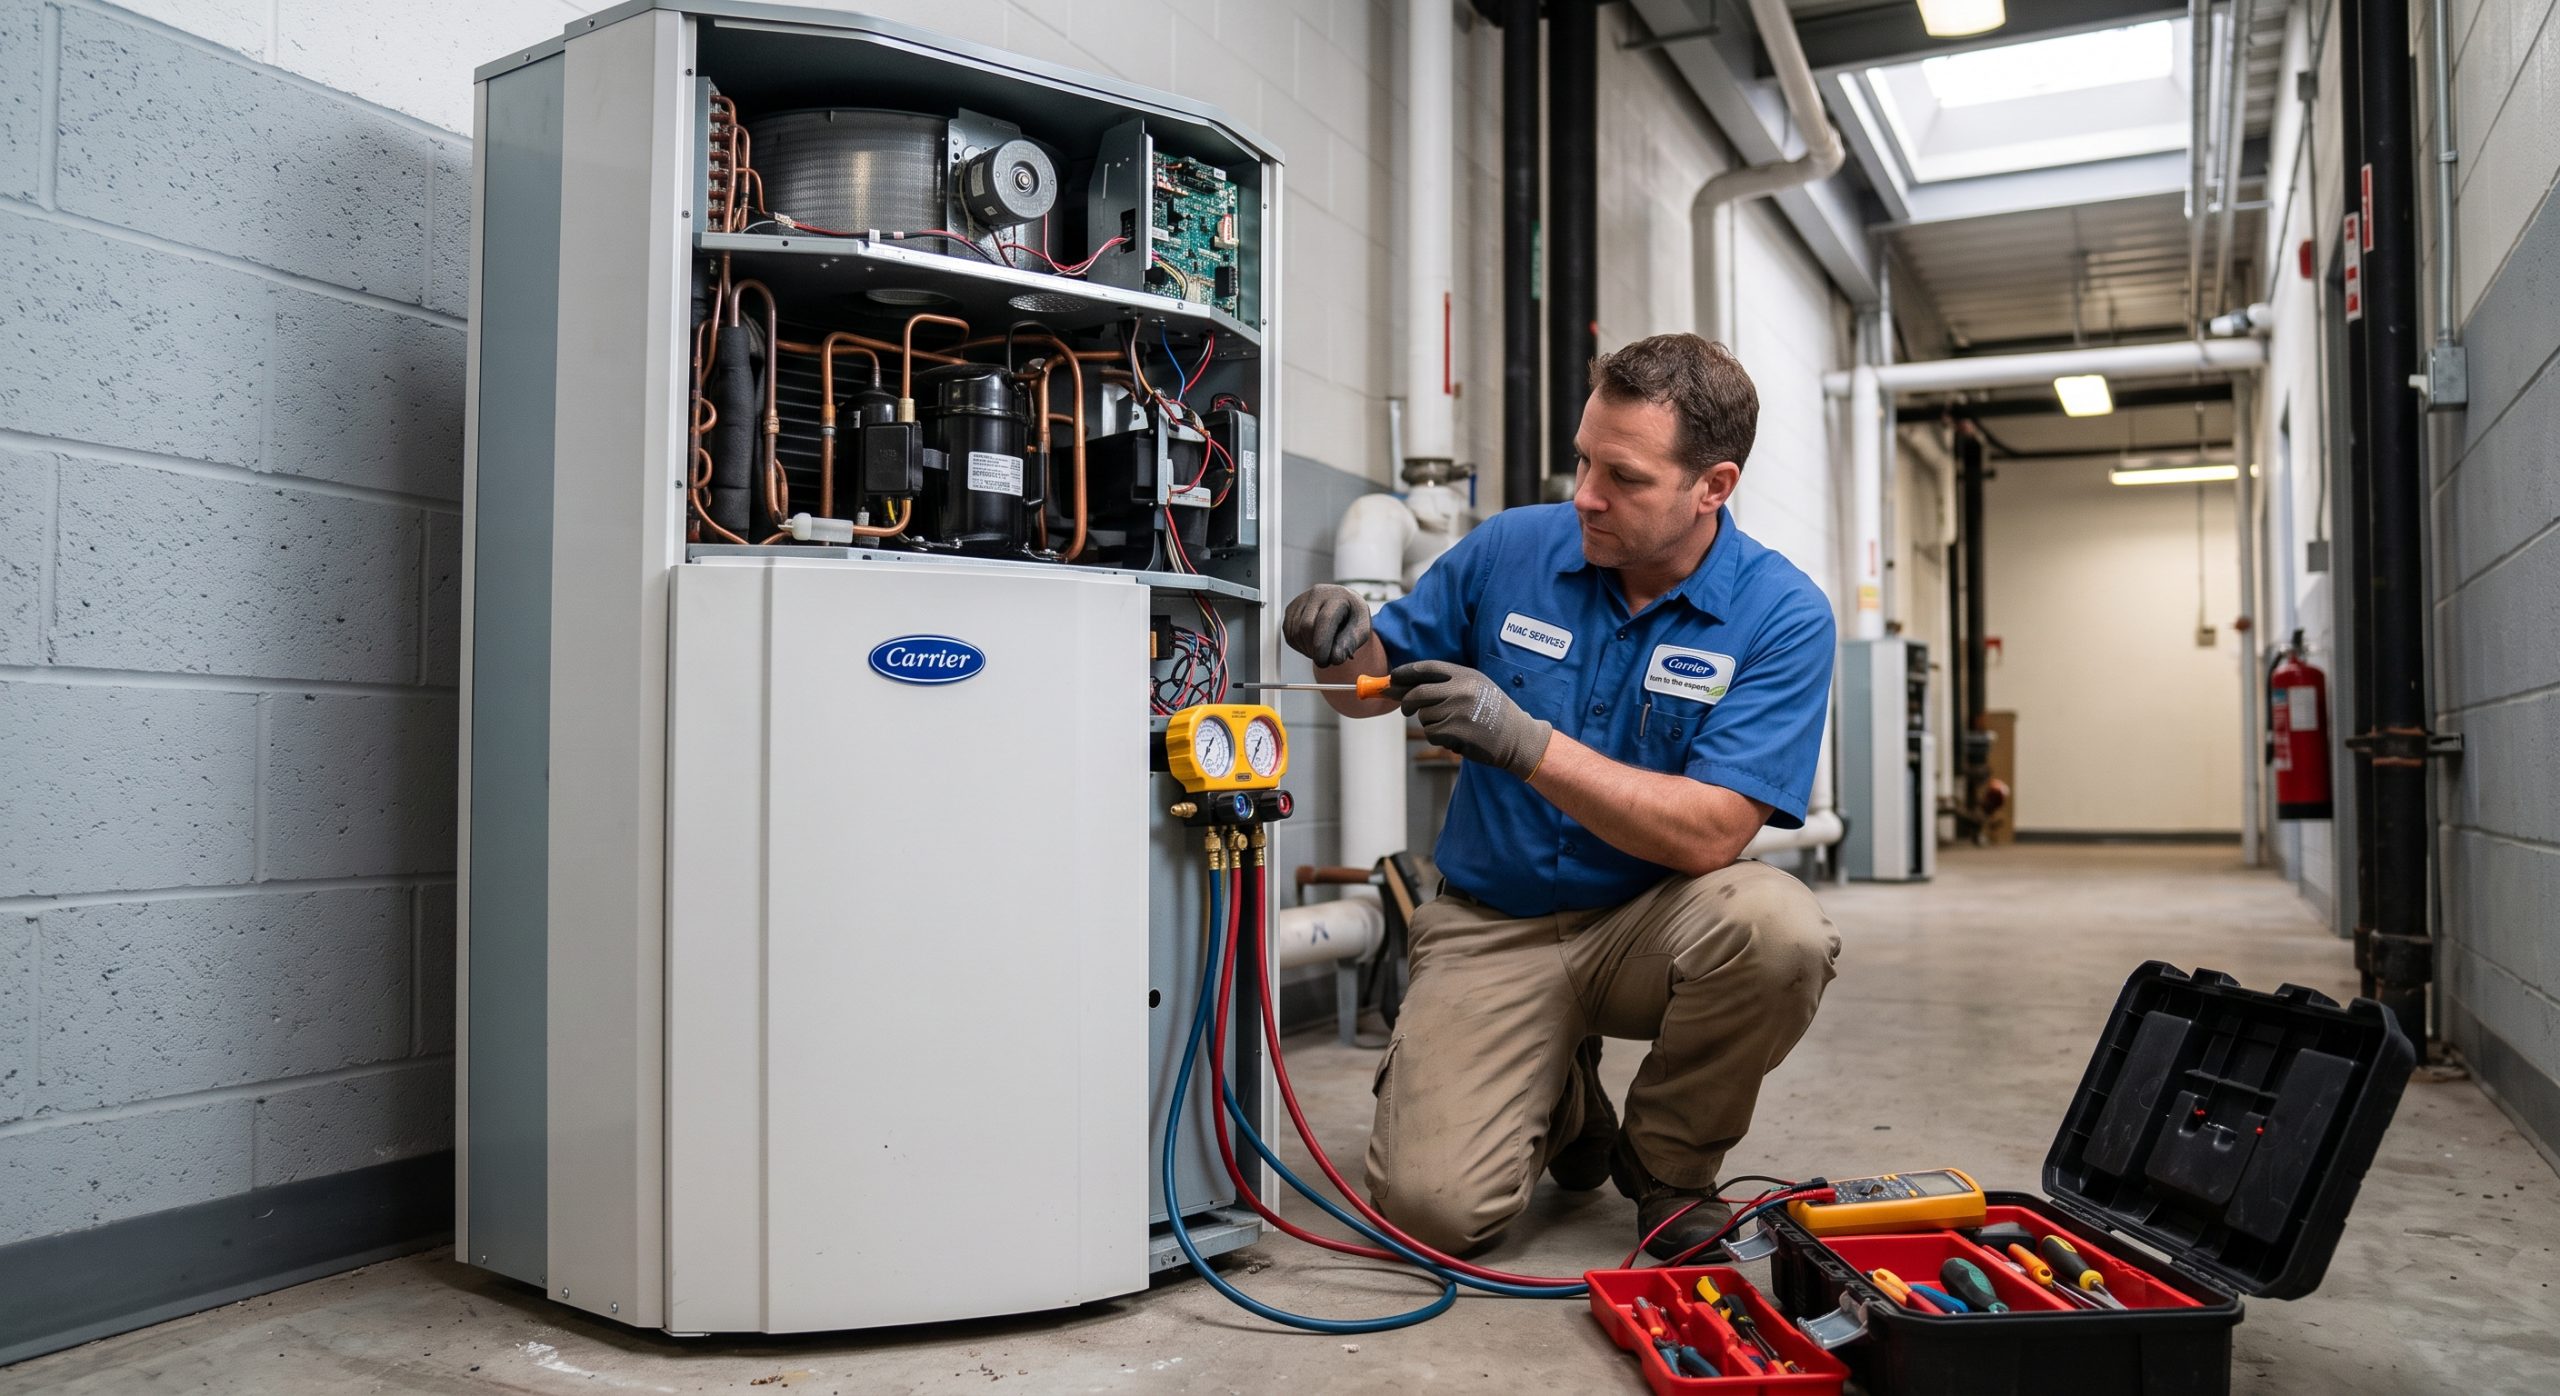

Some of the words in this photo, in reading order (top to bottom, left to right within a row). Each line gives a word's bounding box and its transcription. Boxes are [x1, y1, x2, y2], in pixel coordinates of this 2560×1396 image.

[1506, 622, 1529, 637] HVAC
[886, 646, 971, 669] Carrier
[1668, 658, 1710, 675] Carrier
